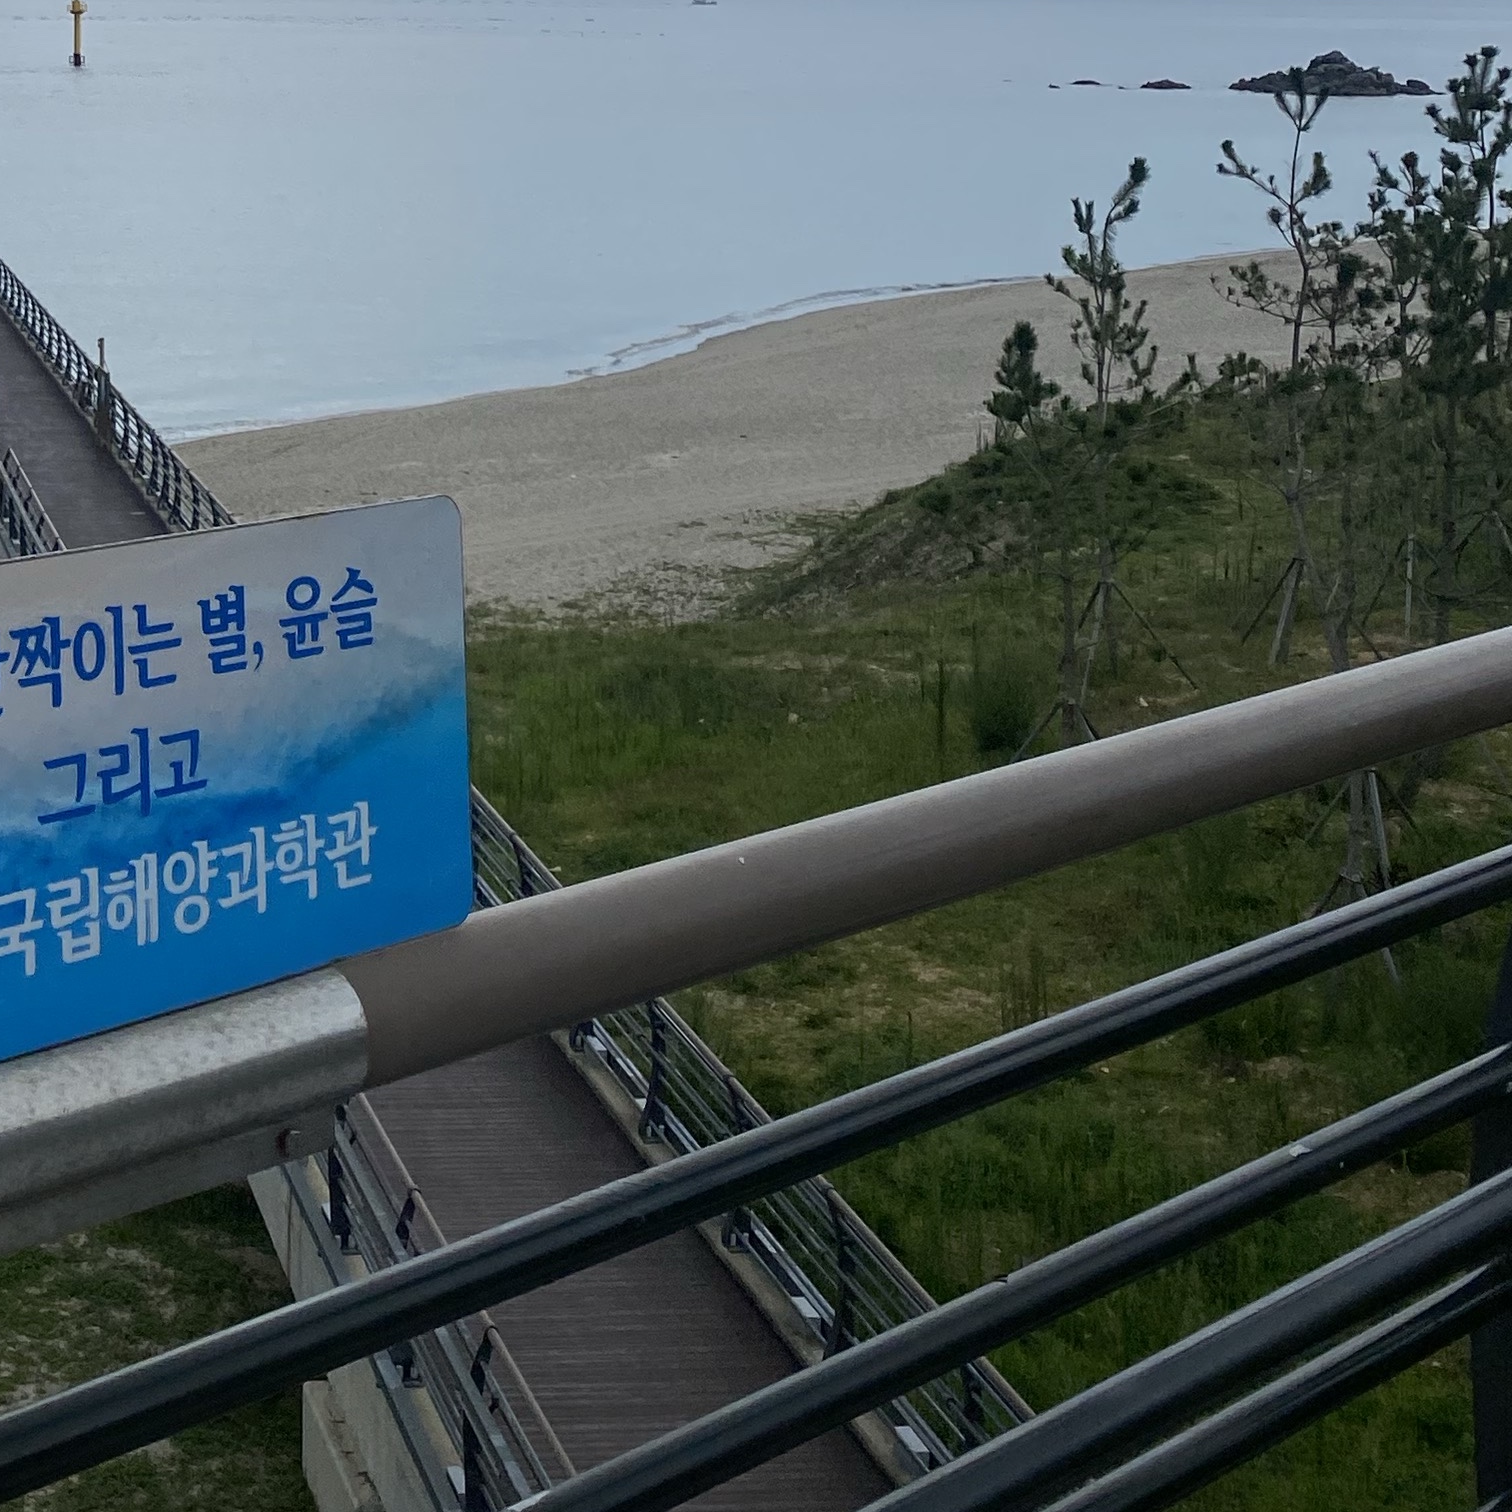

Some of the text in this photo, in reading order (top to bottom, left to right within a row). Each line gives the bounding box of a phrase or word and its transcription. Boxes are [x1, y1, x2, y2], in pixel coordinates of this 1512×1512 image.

[197, 584, 264, 674] 별,
[278, 567, 379, 661] 윤슬
[37, 727, 208, 826] 그리고
